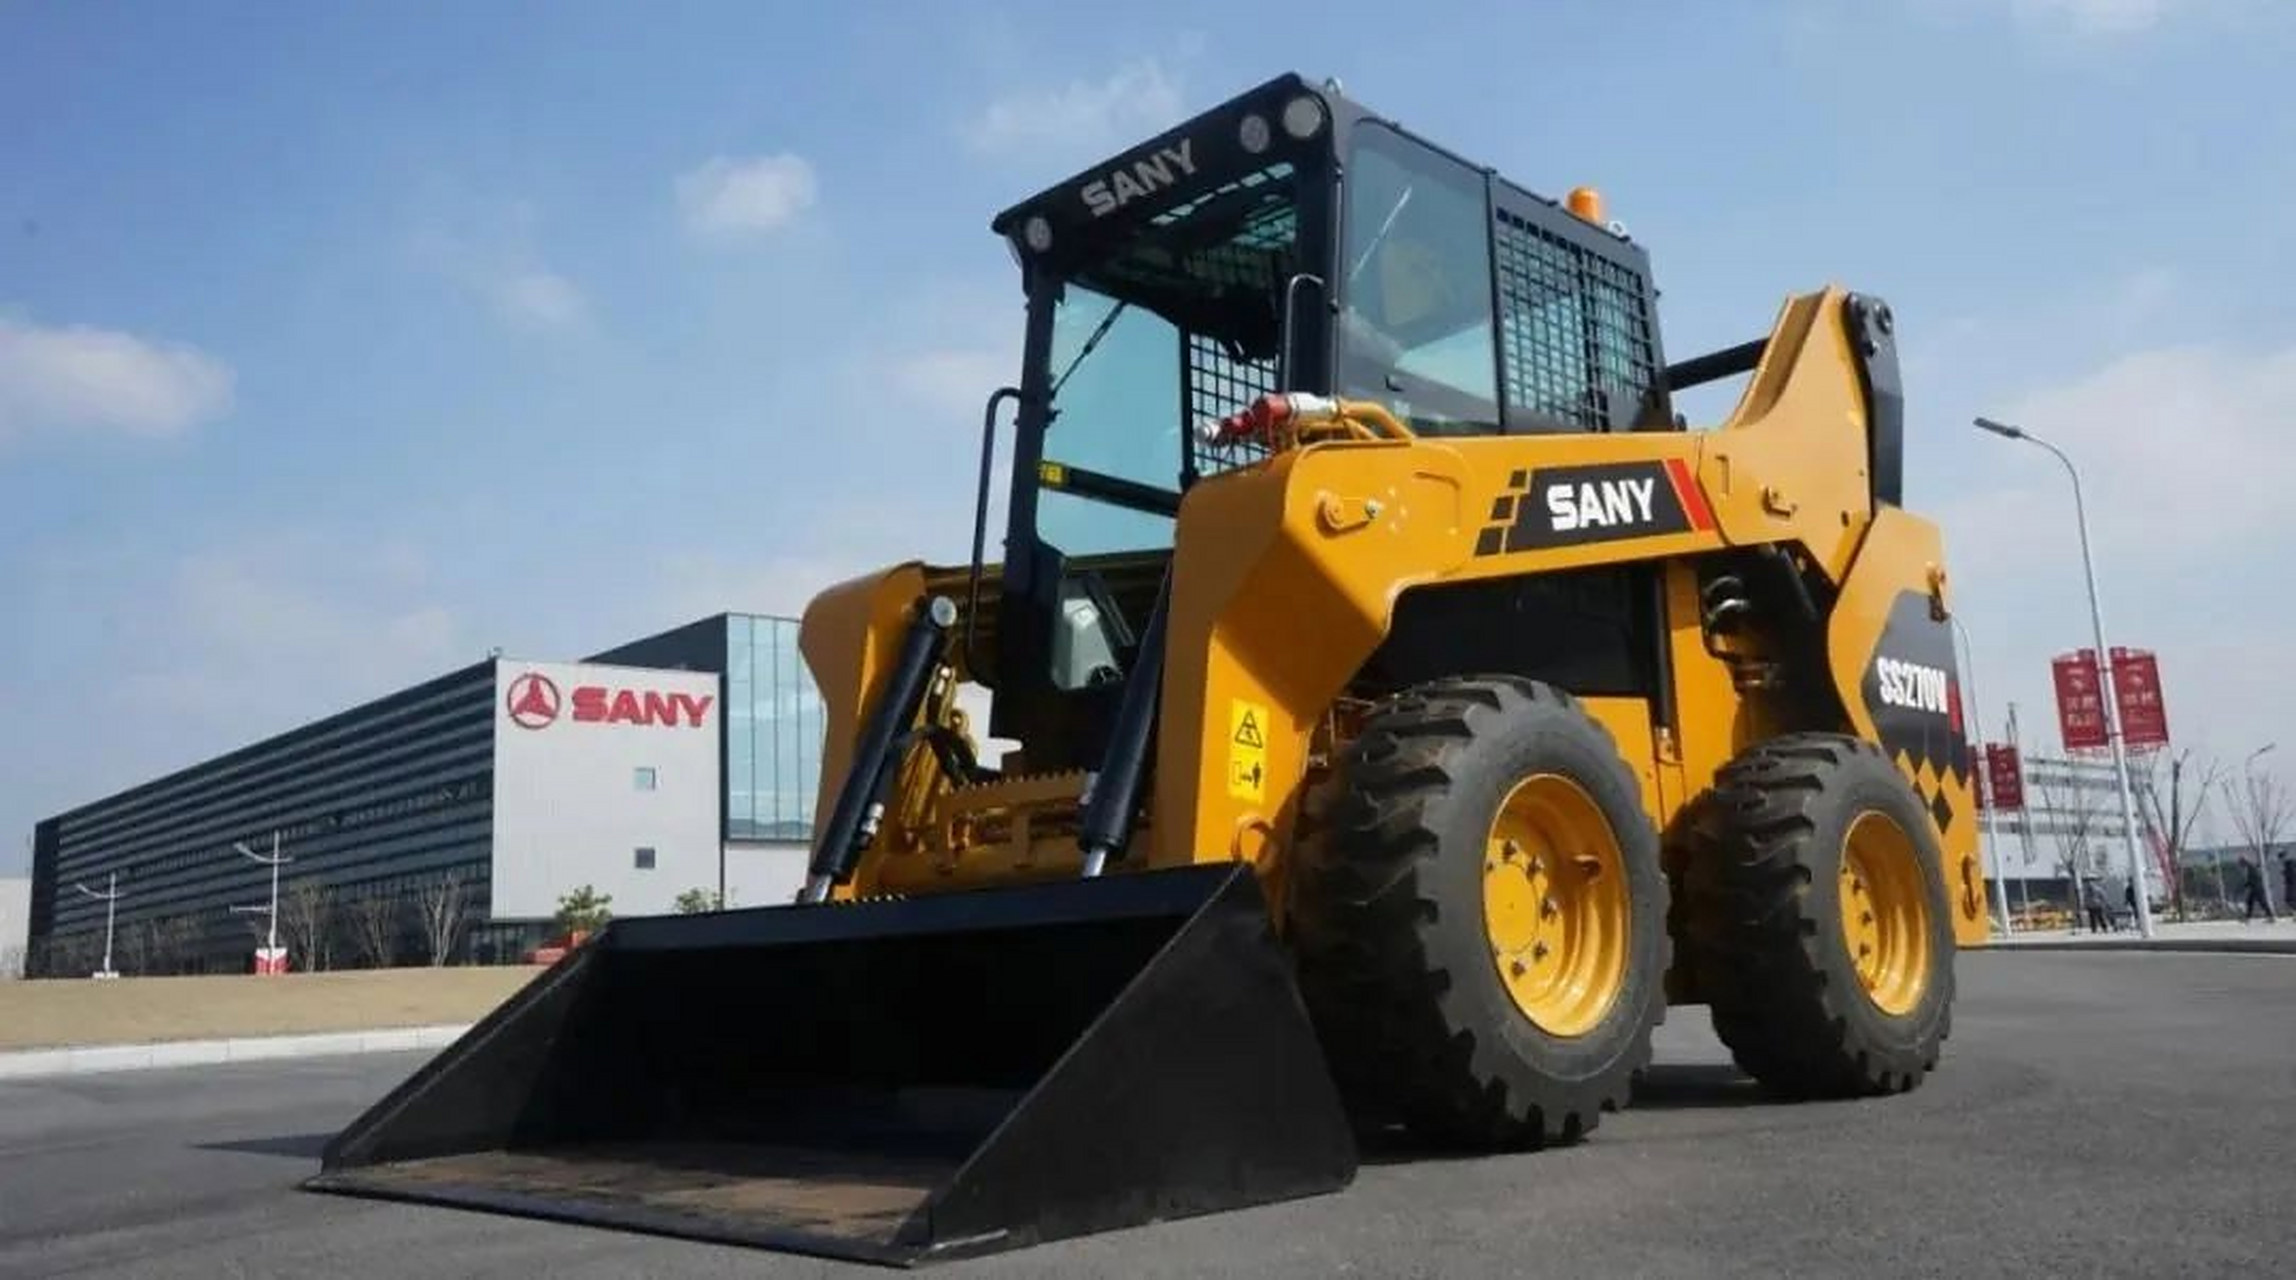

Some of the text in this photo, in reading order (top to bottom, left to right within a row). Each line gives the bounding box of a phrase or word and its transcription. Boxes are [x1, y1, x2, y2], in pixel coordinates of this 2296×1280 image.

[1081, 138, 1196, 217] SANY
[1547, 478, 1654, 531] SANY
[572, 687, 714, 727] SANY
